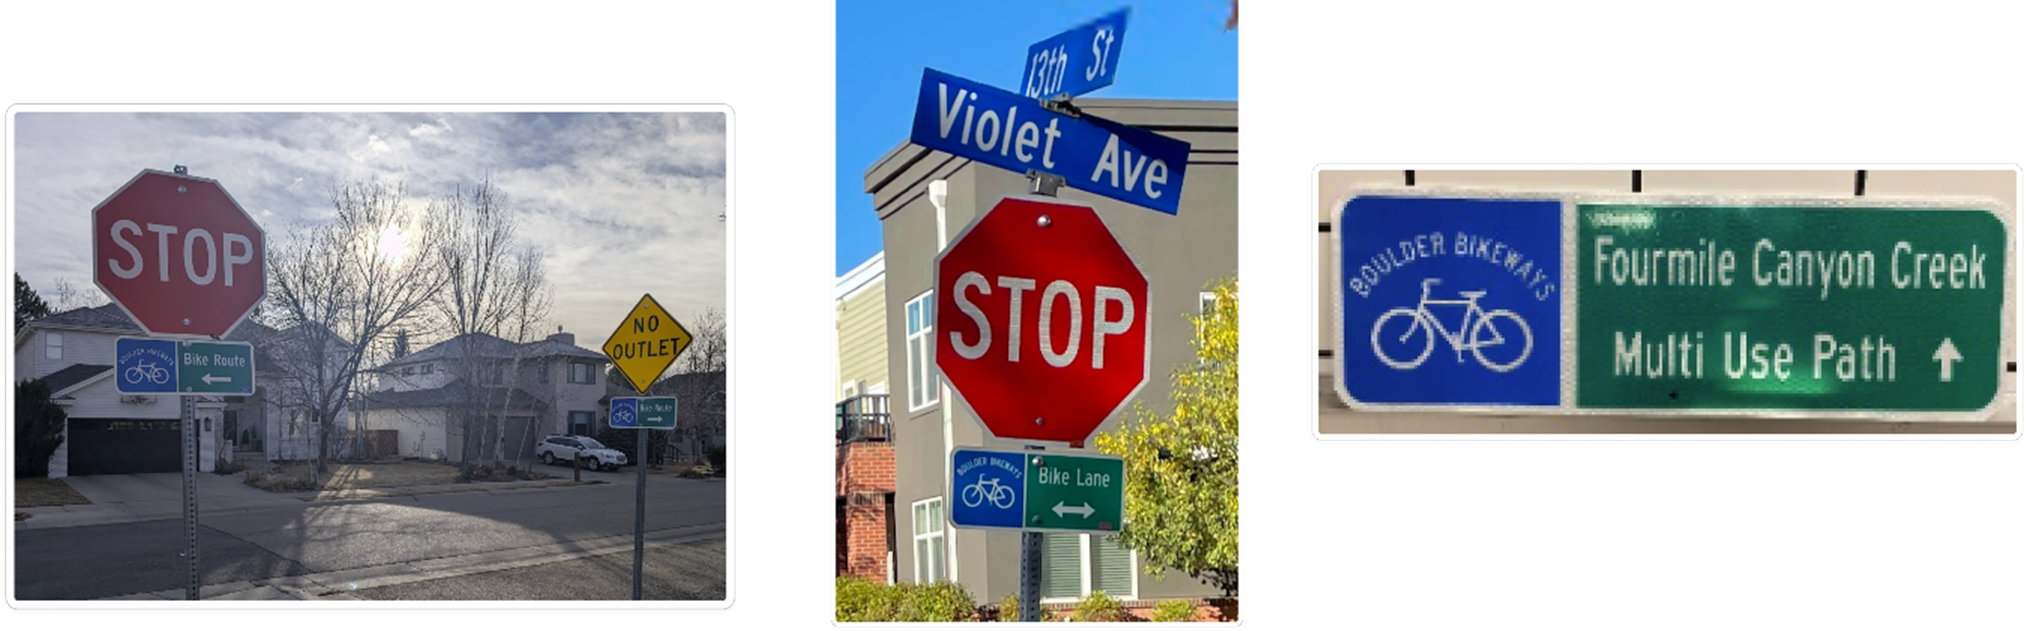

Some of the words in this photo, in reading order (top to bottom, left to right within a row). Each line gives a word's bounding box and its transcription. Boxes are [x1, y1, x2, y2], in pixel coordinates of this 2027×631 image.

[1026, 44, 1068, 99] 13th
[1086, 29, 1114, 82] St
[938, 82, 1062, 169] Violet
[1091, 132, 1168, 199] Ave
[108, 219, 254, 287] STOP
[1350, 231, 1446, 298] BOULDER
[1454, 231, 1555, 301] BIKEWAYS
[1594, 237, 1737, 286] Fourmile
[1752, 239, 1875, 298] Canyon
[1891, 242, 1987, 290] Creek
[633, 315, 660, 334] NO
[950, 271, 1135, 369] STOP
[183, 352, 209, 366] Bike
[213, 354, 246, 368] Route
[613, 337, 680, 360] OUTLET
[1613, 332, 1703, 379] Multi
[1723, 332, 1793, 380] Use
[1812, 334, 1897, 381] Path
[956, 456, 988, 476] BOULDER
[1039, 466, 1070, 486] Bike
[1077, 468, 1111, 488] Lane
